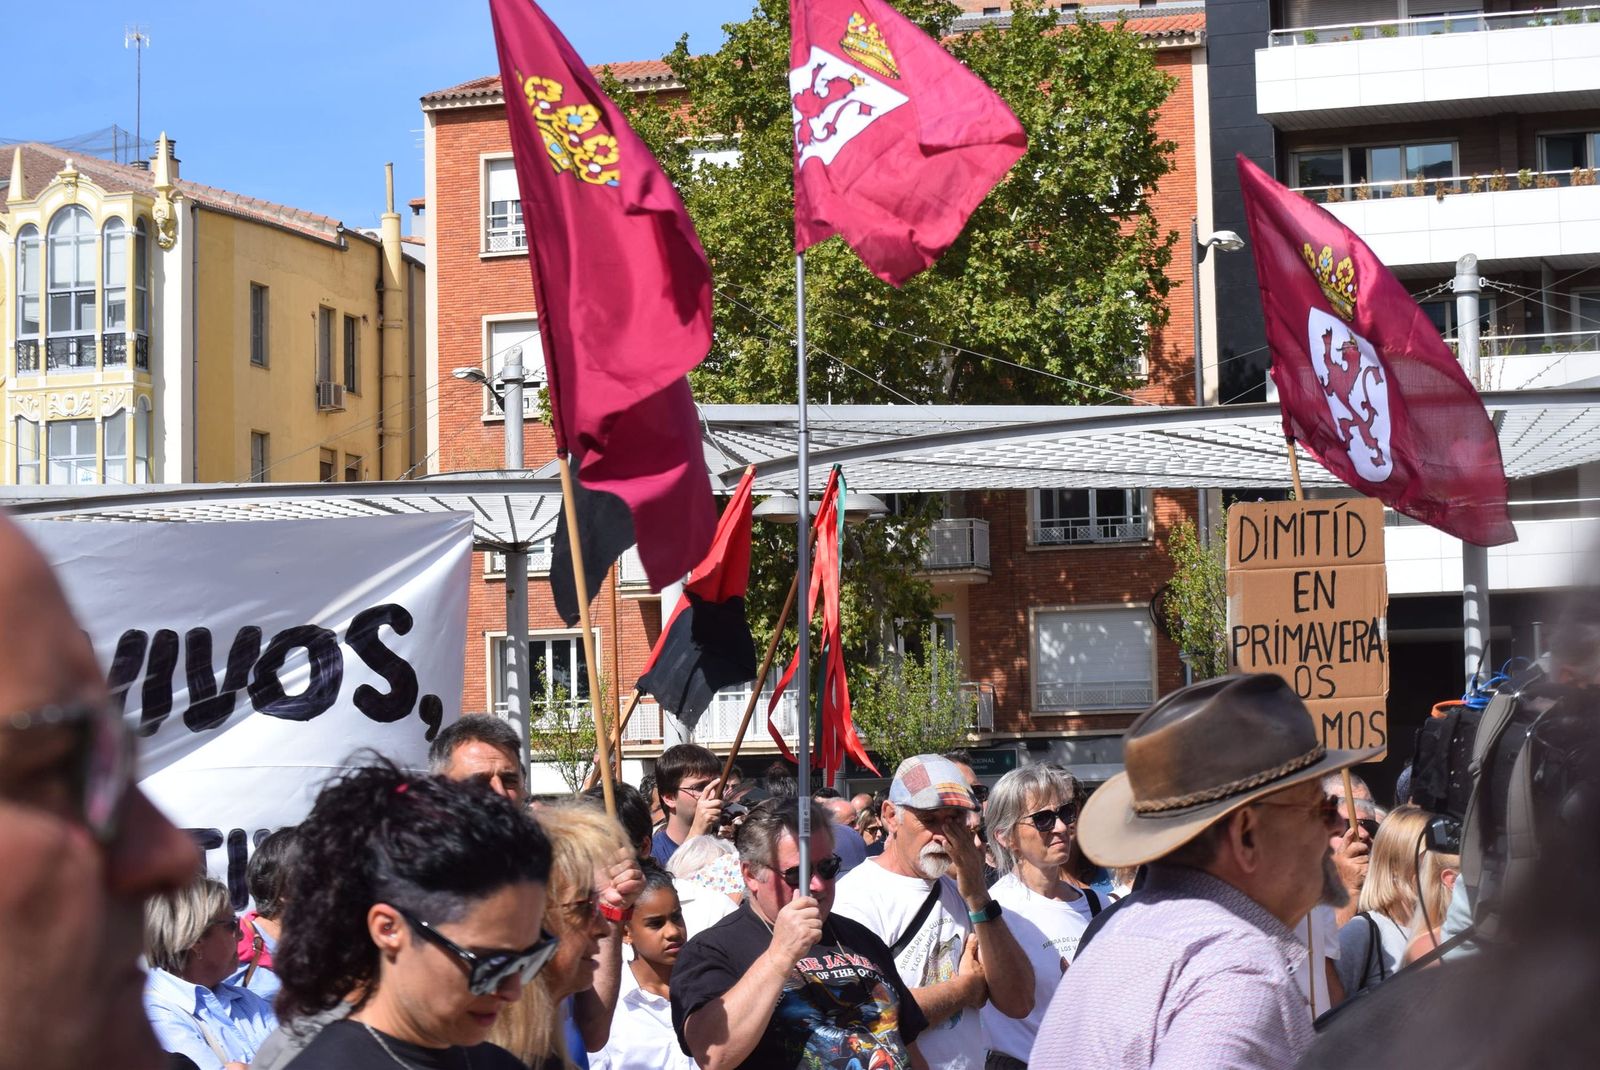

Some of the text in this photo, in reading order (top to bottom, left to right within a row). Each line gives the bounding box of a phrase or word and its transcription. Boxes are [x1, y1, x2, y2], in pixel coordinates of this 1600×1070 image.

[1293, 570, 1336, 613] EN
[1232, 617, 1385, 667] PRIMAVERA
[1294, 664, 1336, 699] OS
[816, 971, 830, 980] OF
[830, 967, 856, 979] THE
